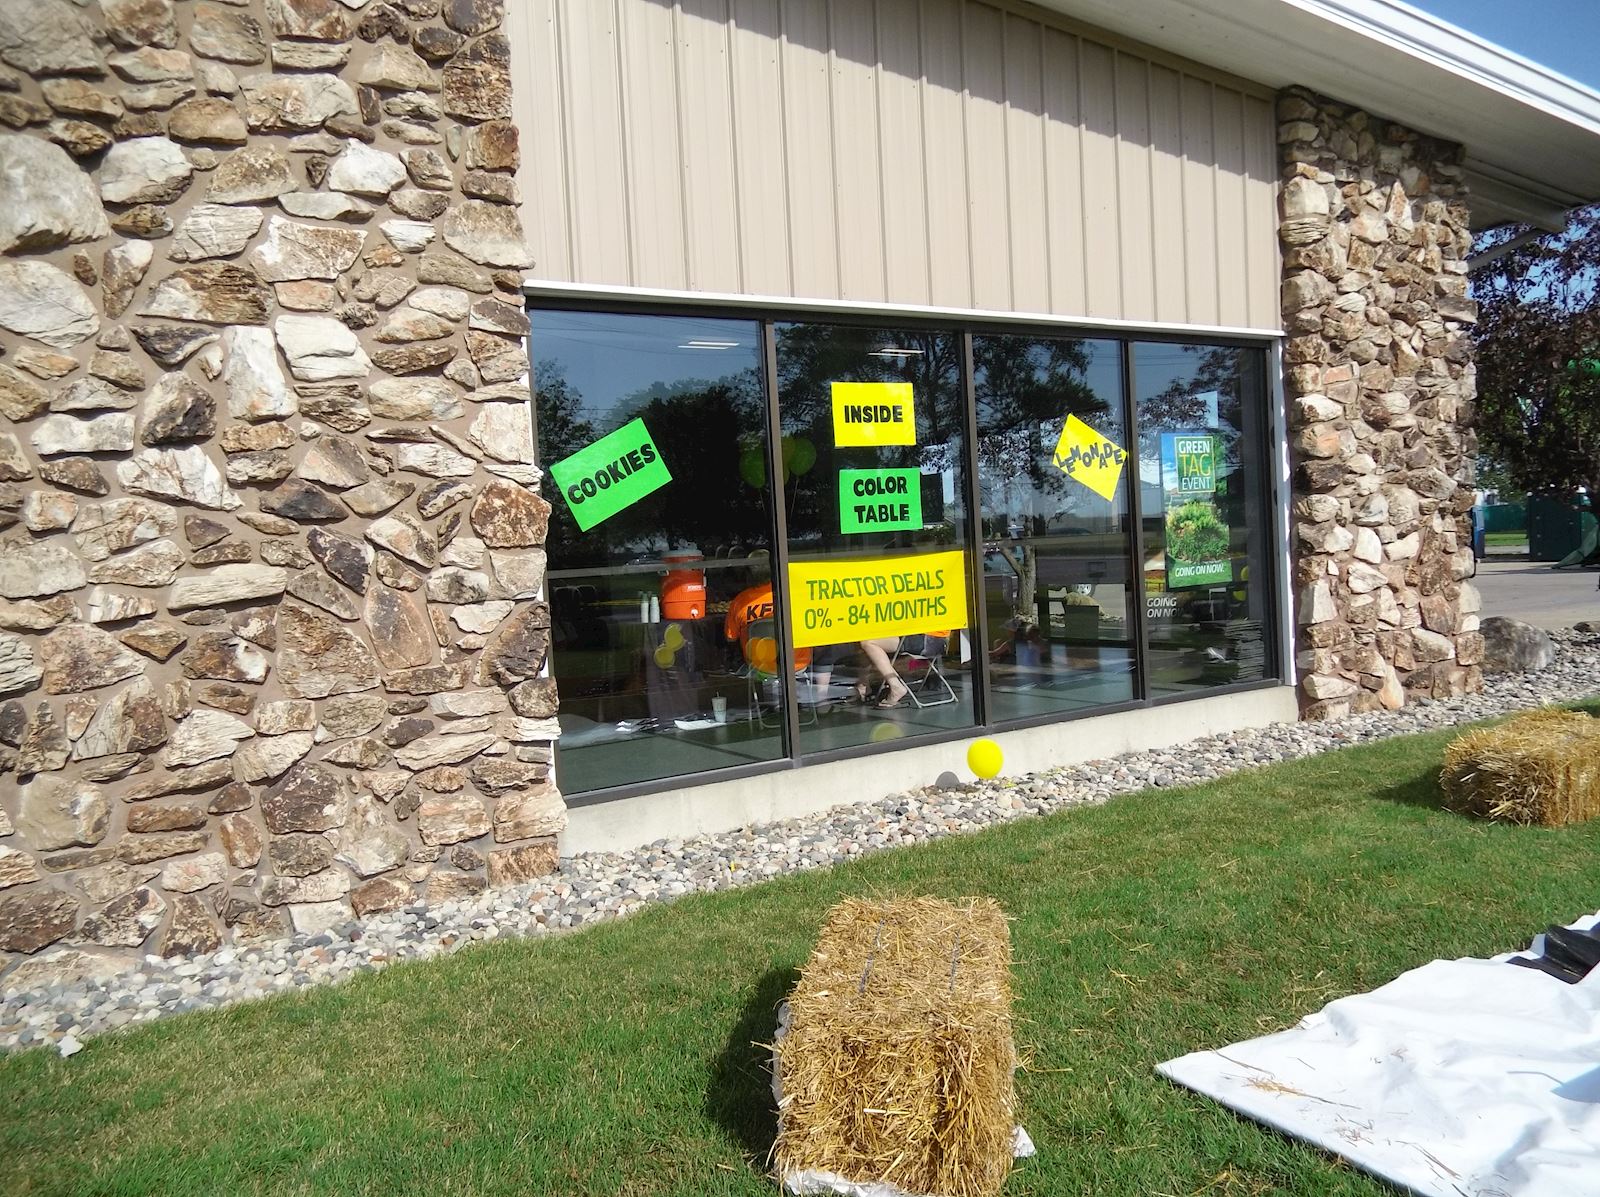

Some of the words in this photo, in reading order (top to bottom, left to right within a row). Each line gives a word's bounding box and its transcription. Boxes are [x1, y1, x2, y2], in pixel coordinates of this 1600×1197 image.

[844, 405, 903, 423] INSIDE
[1178, 440, 1210, 454] GREEN
[1055, 442, 1123, 474] LEMONADE
[1179, 453, 1211, 477] TAG
[567, 443, 656, 504] COOKIES
[853, 476, 908, 497] COLOR
[1182, 477, 1211, 490] EVENT
[854, 504, 910, 523] TABLE
[1175, 566, 1195, 577] GOING
[1195, 565, 1206, 575] ON
[1206, 563, 1225, 574] NOW.
[806, 575, 888, 600] TRACTOR
[891, 569, 944, 594] DEALS
[746, 602, 774, 620] KF
[1146, 597, 1177, 607] GOING
[804, 608, 832, 630] 0%
[848, 604, 870, 626] 84
[875, 596, 947, 623] MONTHS
[1147, 608, 1162, 618] ON
